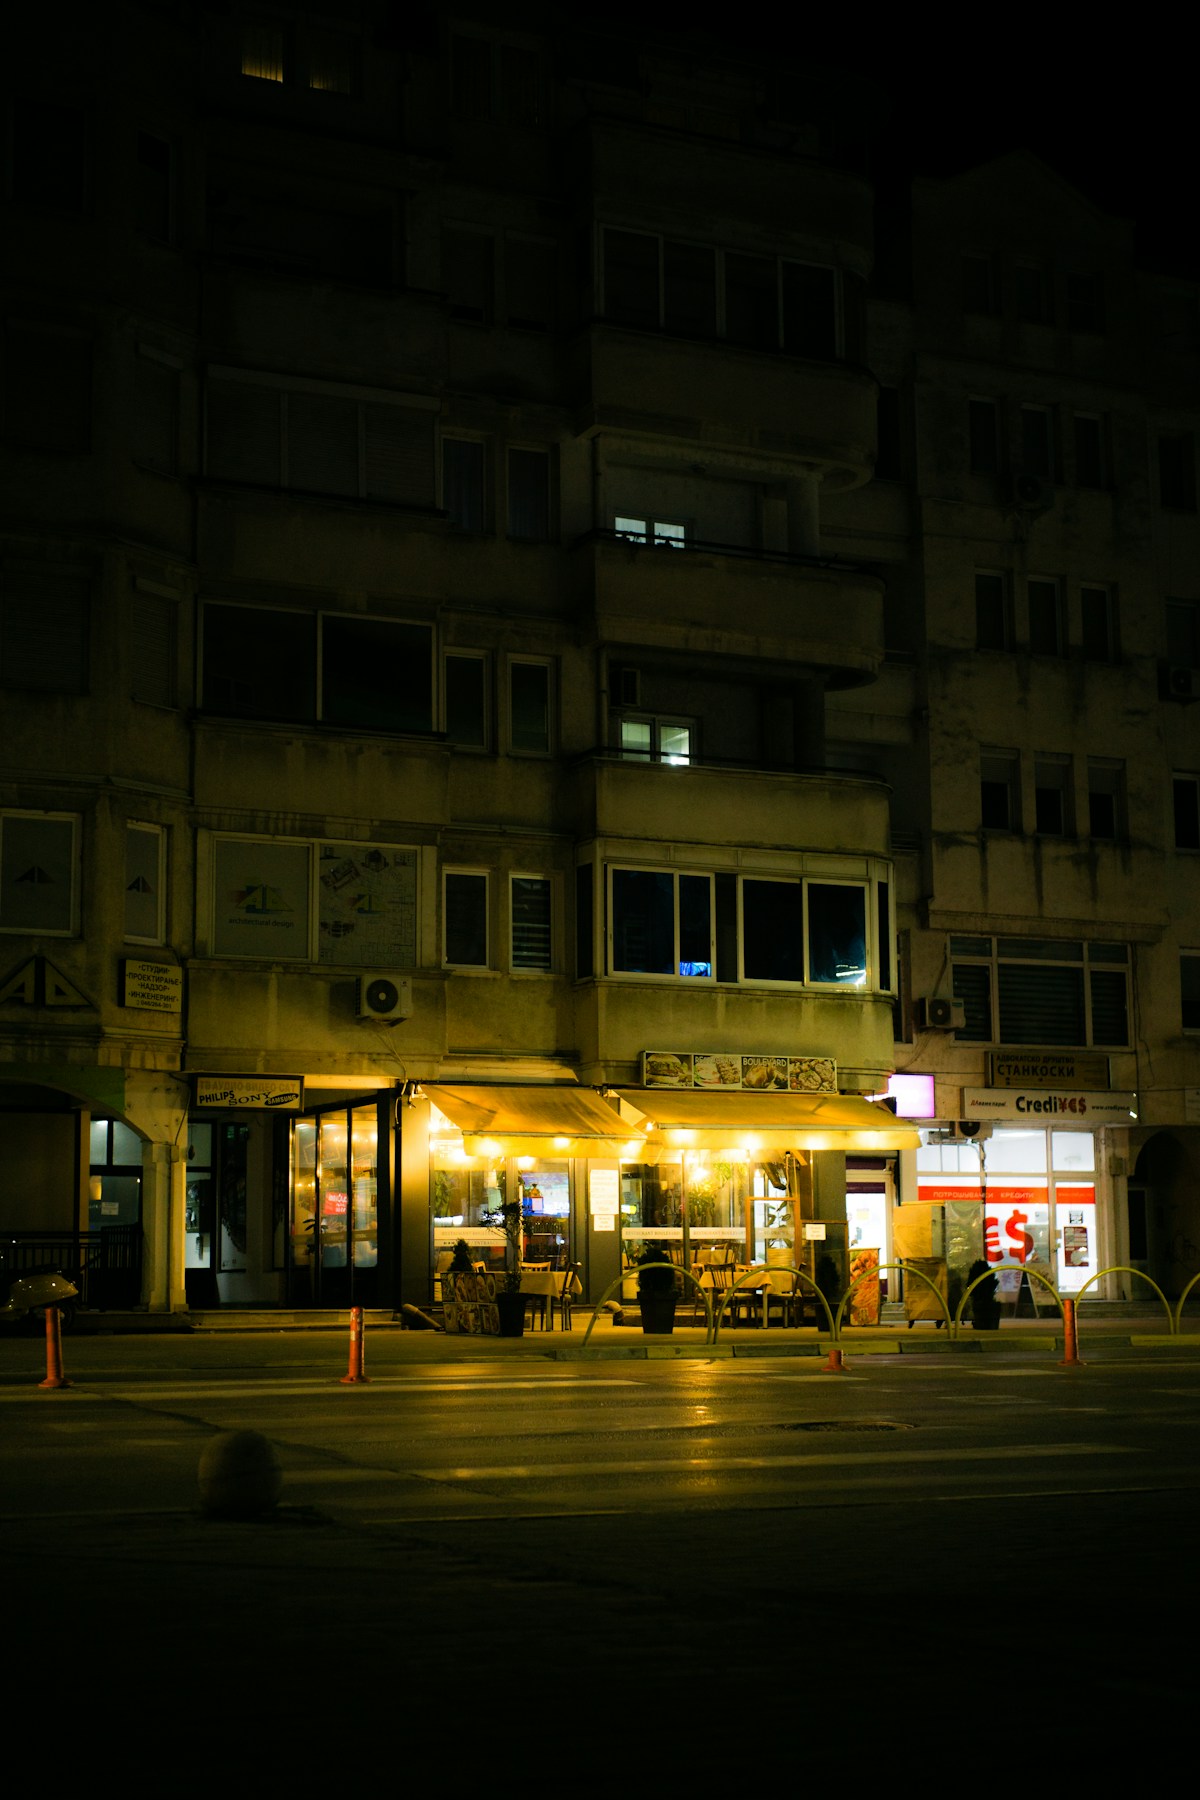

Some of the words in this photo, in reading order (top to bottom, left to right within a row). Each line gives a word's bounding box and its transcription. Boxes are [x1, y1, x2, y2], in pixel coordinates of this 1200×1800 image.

[272, 919, 294, 929] design
[140, 983, 168, 992] НАДЗОР
[130, 991, 177, 1002] ИНЖЕНЕРИНГ
[742, 1057, 787, 1067] BOULEVARD
[996, 1055, 1041, 1063] АДВОКАТСКО
[1042, 1056, 1075, 1064] ДРУШТВО
[997, 1064, 1075, 1078] СТАНКОСКИ
[212, 1081, 244, 1091] АУДИО
[245, 1082, 277, 1092] ВИДЕО
[199, 1090, 235, 1104] PHILIPS
[228, 1091, 272, 1106] SONY
[266, 1094, 298, 1105] SAMSUNG
[1000, 1192, 1035, 1200] КРЕДИТИ
